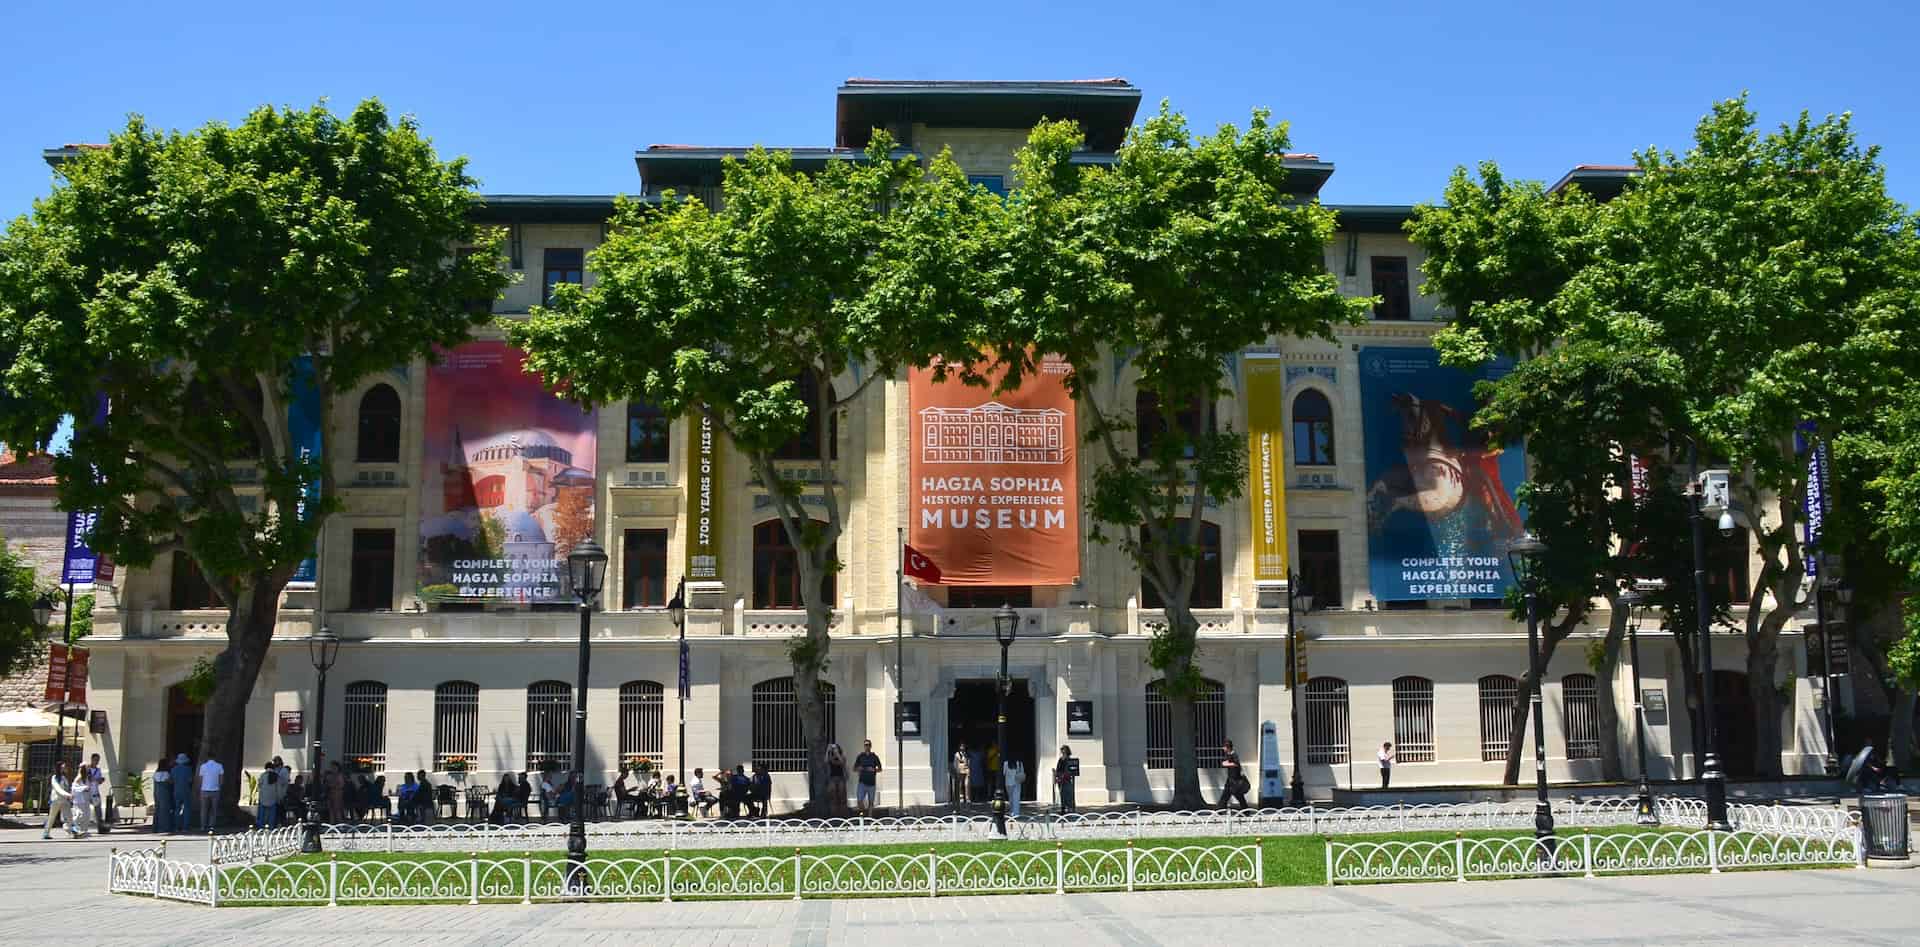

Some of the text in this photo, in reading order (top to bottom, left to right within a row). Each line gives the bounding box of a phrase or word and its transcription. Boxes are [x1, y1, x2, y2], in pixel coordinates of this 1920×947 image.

[699, 402, 711, 545] 1700 YEARS OF HISTOY
[921, 477, 1063, 492] HAGIA SOPHIA
[1261, 431, 1274, 545] SACRED ARTIFACTS
[921, 495, 1064, 505] HISTORY & EXPERIENCE
[921, 508, 1065, 529] MUSEUM
[453, 559, 559, 569] COMPLETE YOUR
[1401, 557, 1500, 567] COMPLETE YOUR
[452, 573, 559, 583] HAGIA SOPHIA
[1402, 570, 1501, 581] HAGIA SOPHIA
[459, 587, 552, 597] EXPERIENCE
[1409, 583, 1495, 594] EXPERIENCE
